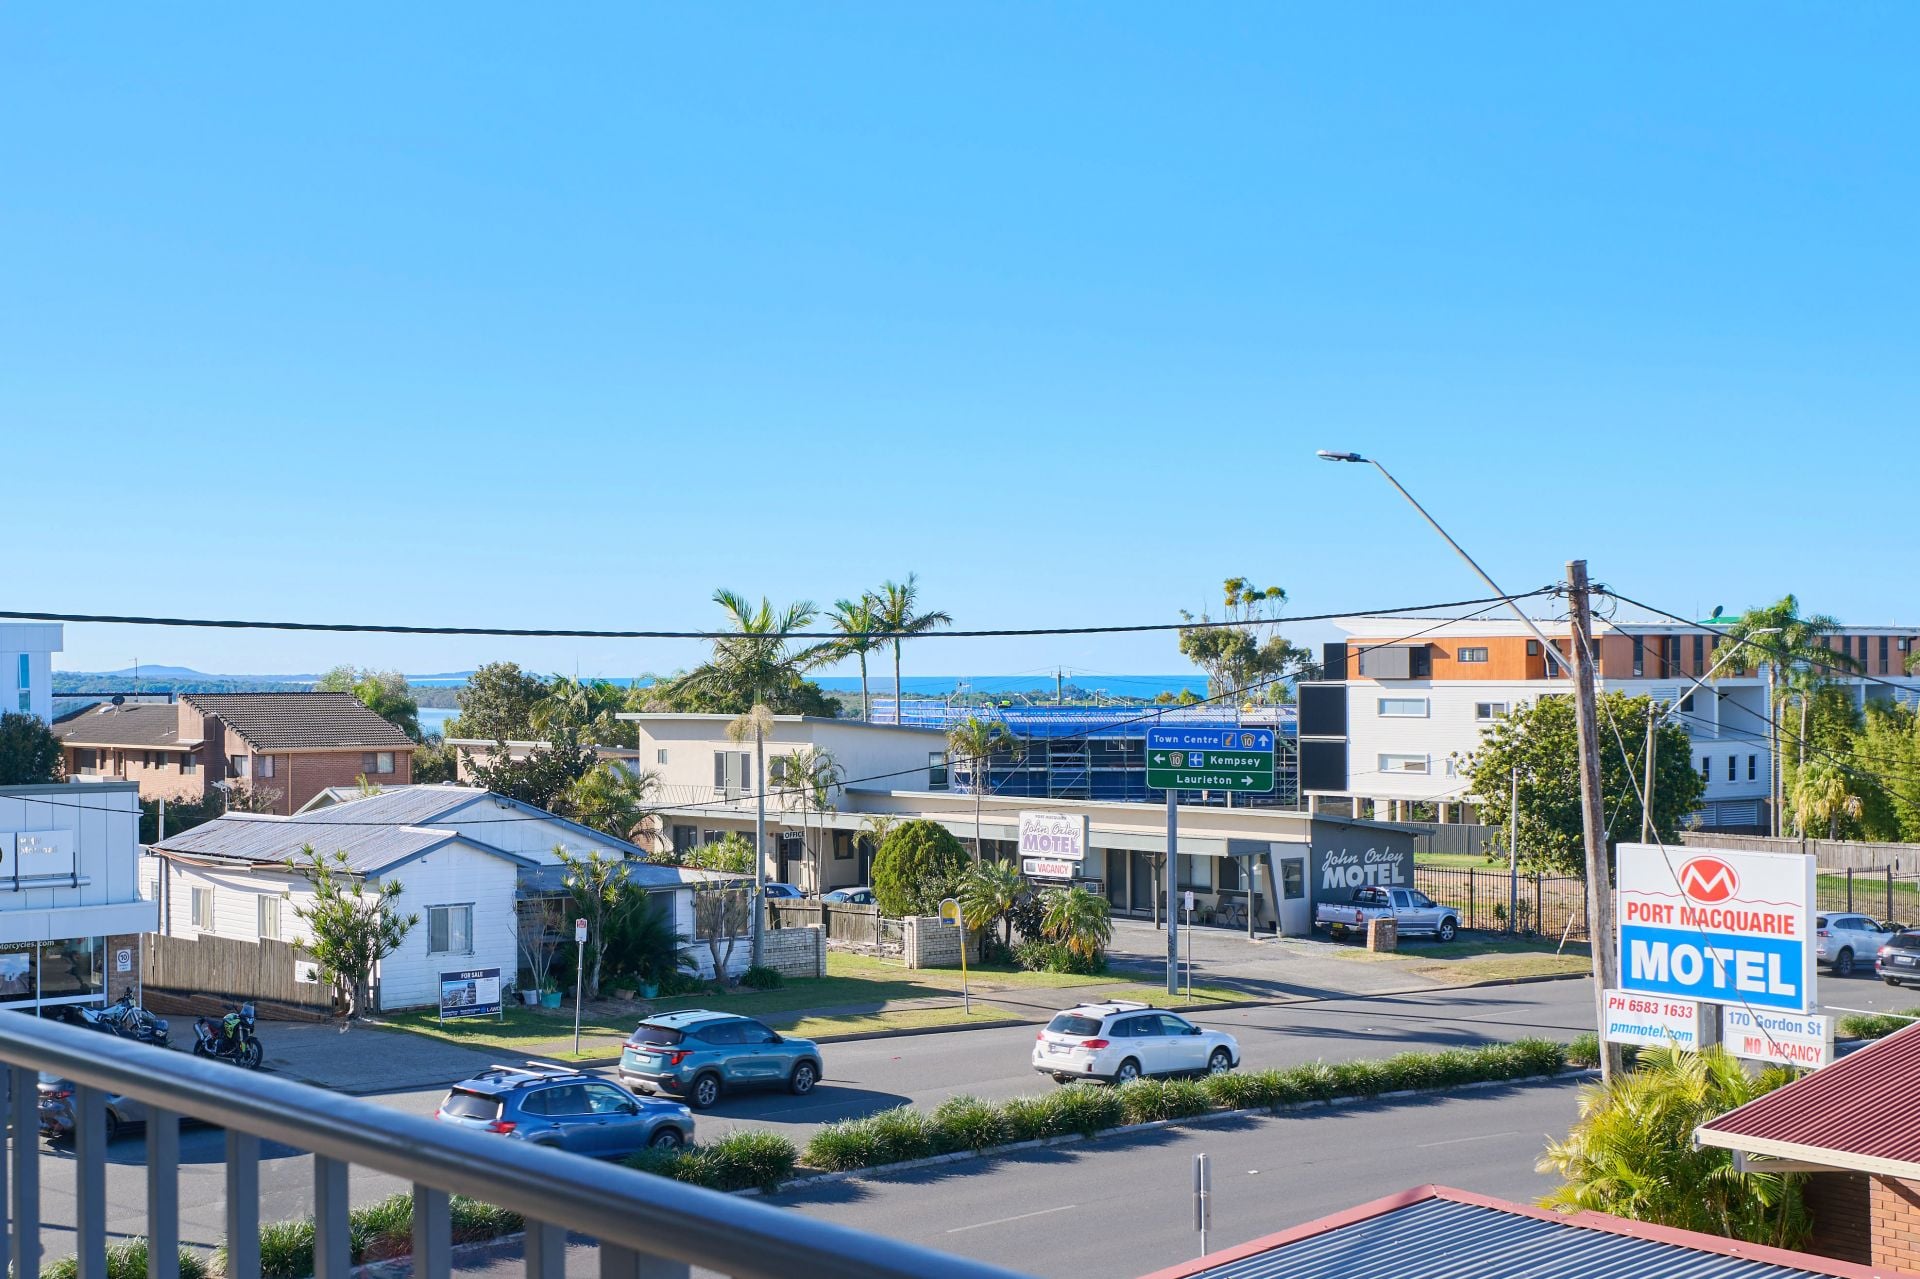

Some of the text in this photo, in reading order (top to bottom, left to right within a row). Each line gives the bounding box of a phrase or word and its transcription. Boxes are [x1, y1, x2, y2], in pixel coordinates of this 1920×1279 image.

[1154, 735, 1252, 746] Town Centre 10
[1172, 756, 1260, 767] 10 Kempsey
[1176, 775, 1232, 785] Laurieton
[1023, 819, 1080, 839] John Oxley
[1023, 834, 1079, 854] MOTEL
[1037, 863, 1069, 874] VACANCY
[1322, 846, 1404, 871] John Oxley
[1322, 862, 1405, 889] MOTEL
[1627, 901, 1795, 935] PORT MACQUARIE
[1631, 939, 1796, 996] MOTEL
[1608, 997, 1693, 1018] PH 6583 1633
[1610, 1022, 1693, 1041] pmmotel.com
[1729, 1011, 1822, 1035] 170 Gordon St
[1745, 1036, 1821, 1063] NO VACANCY
